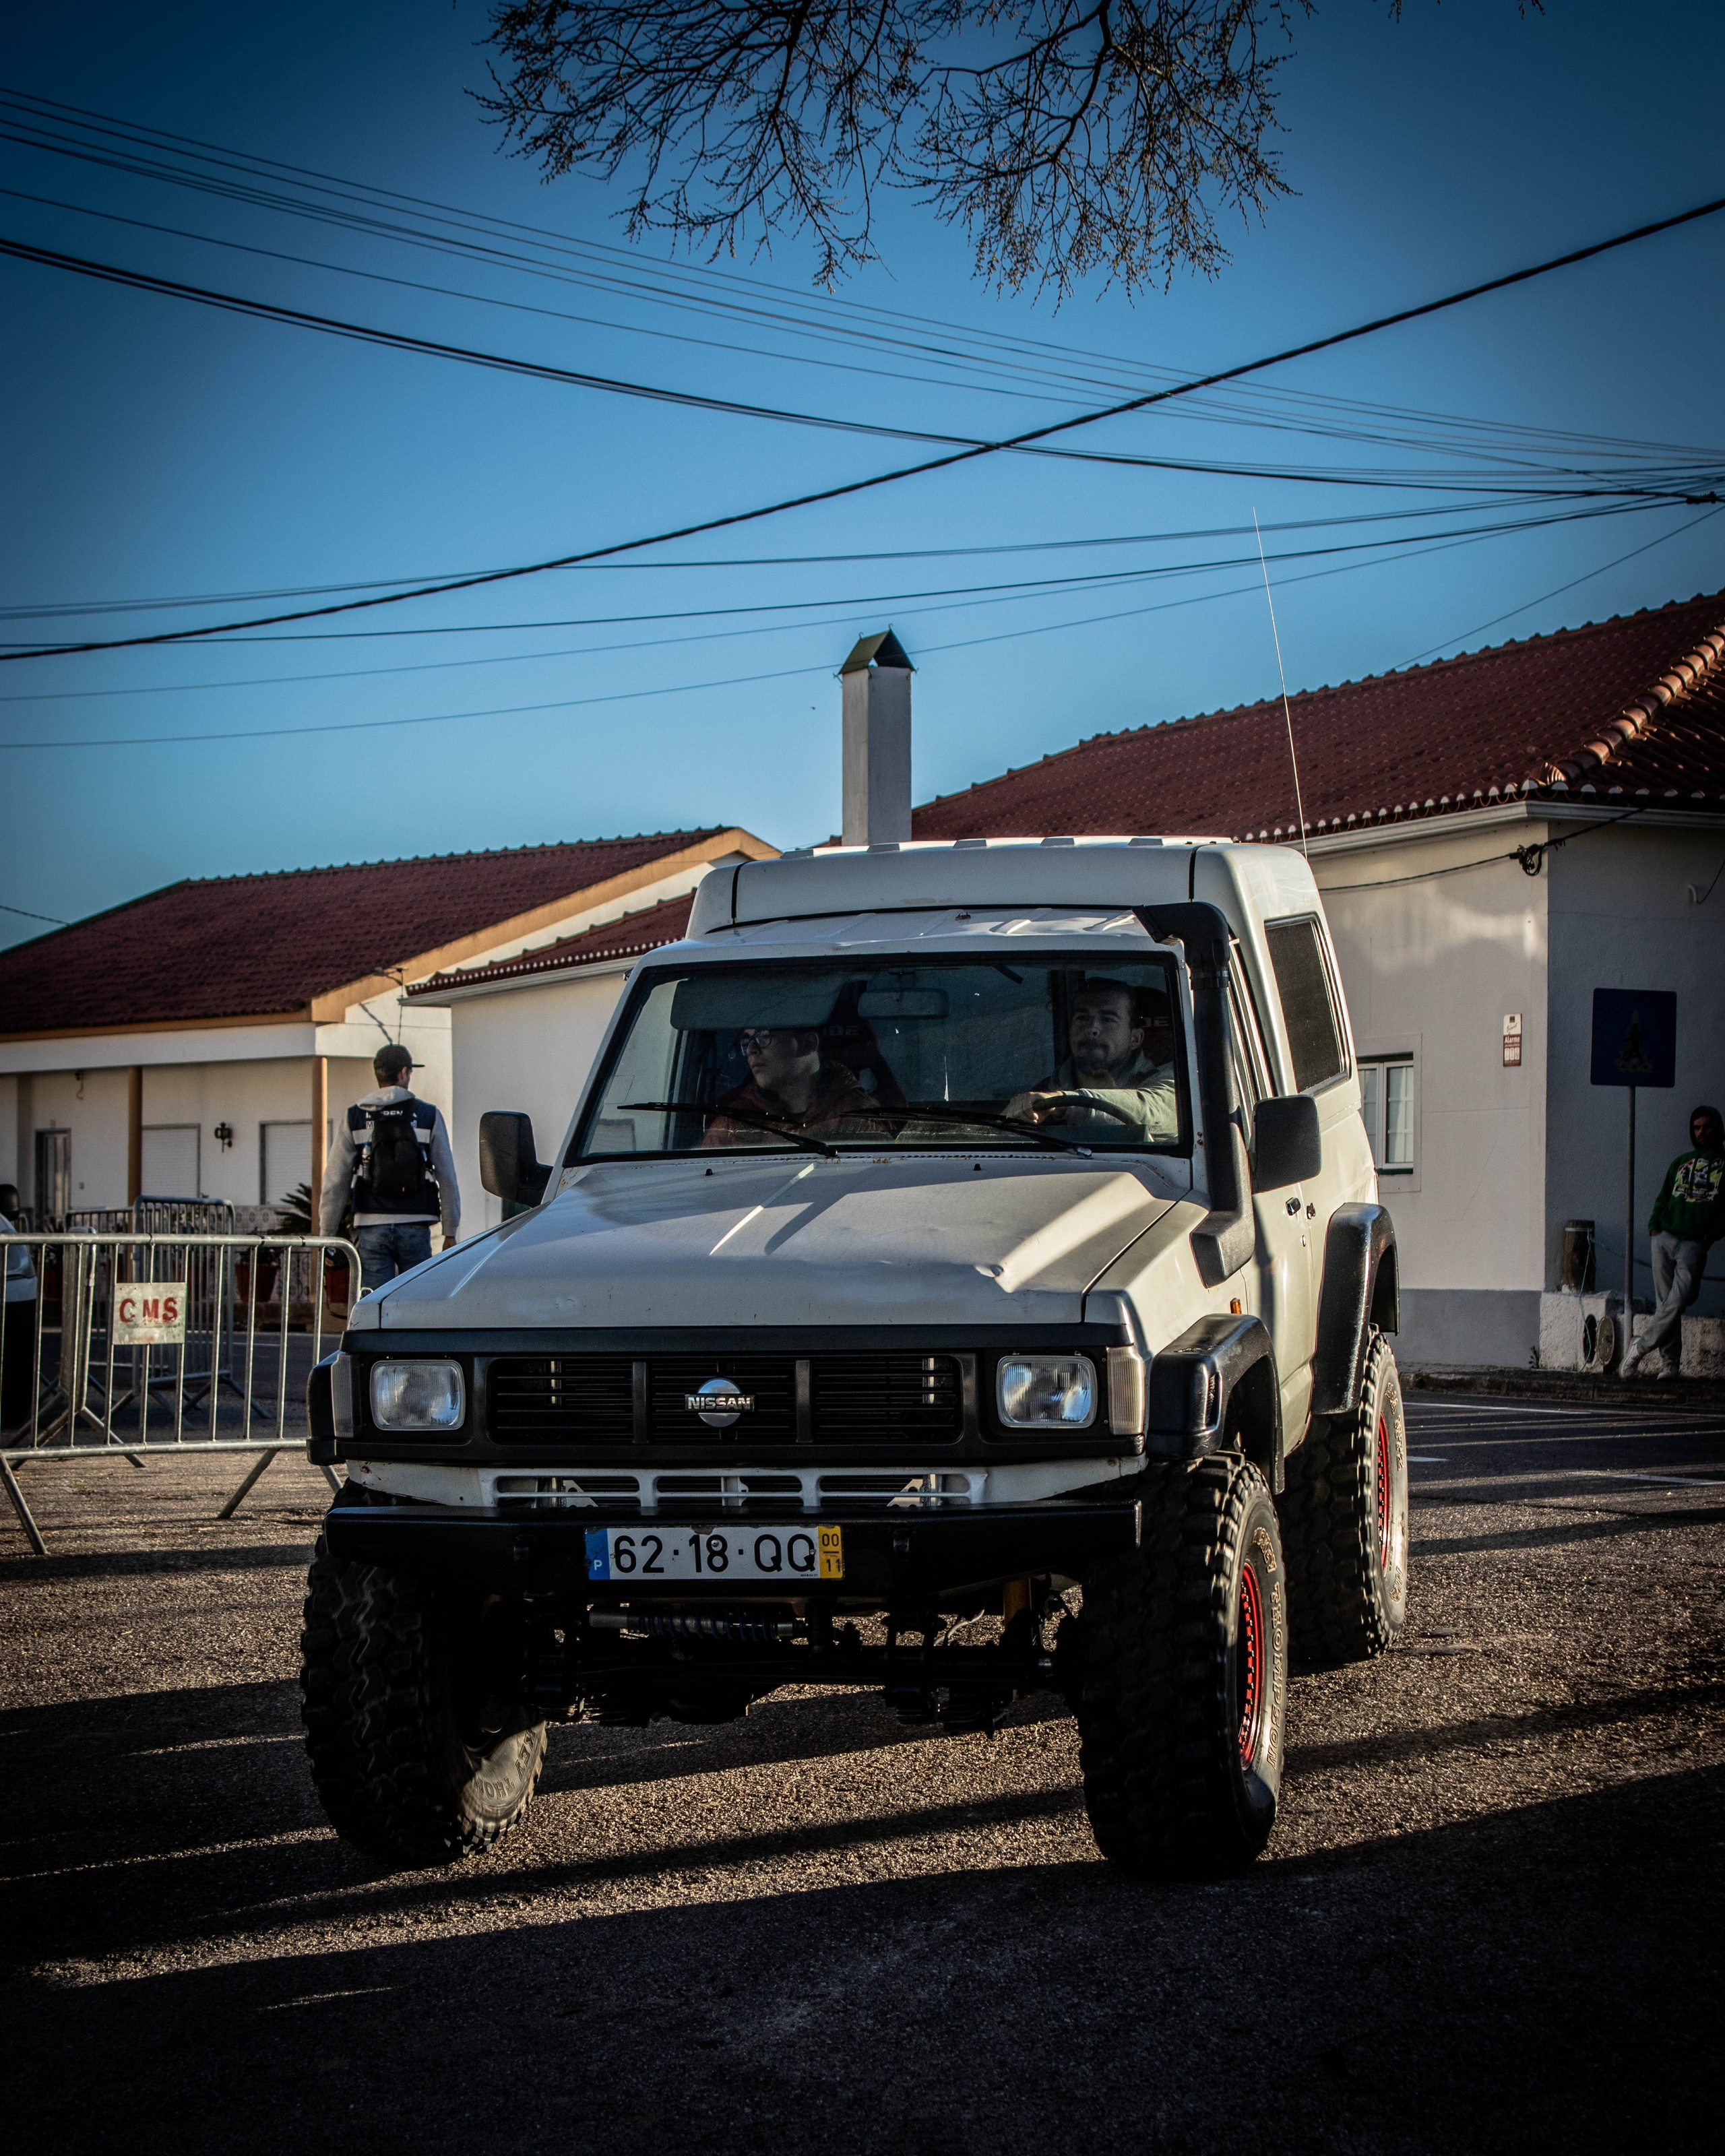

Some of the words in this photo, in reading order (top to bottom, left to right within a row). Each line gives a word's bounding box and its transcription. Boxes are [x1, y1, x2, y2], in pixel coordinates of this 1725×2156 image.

[119, 1297, 178, 1323] CMS
[688, 1397, 751, 1410] NISSAN
[821, 1533, 840, 1547] 00
[593, 1560, 602, 1571] P
[826, 1558, 841, 1573] 11
[1267, 1581, 1283, 1770] THOMPSON
